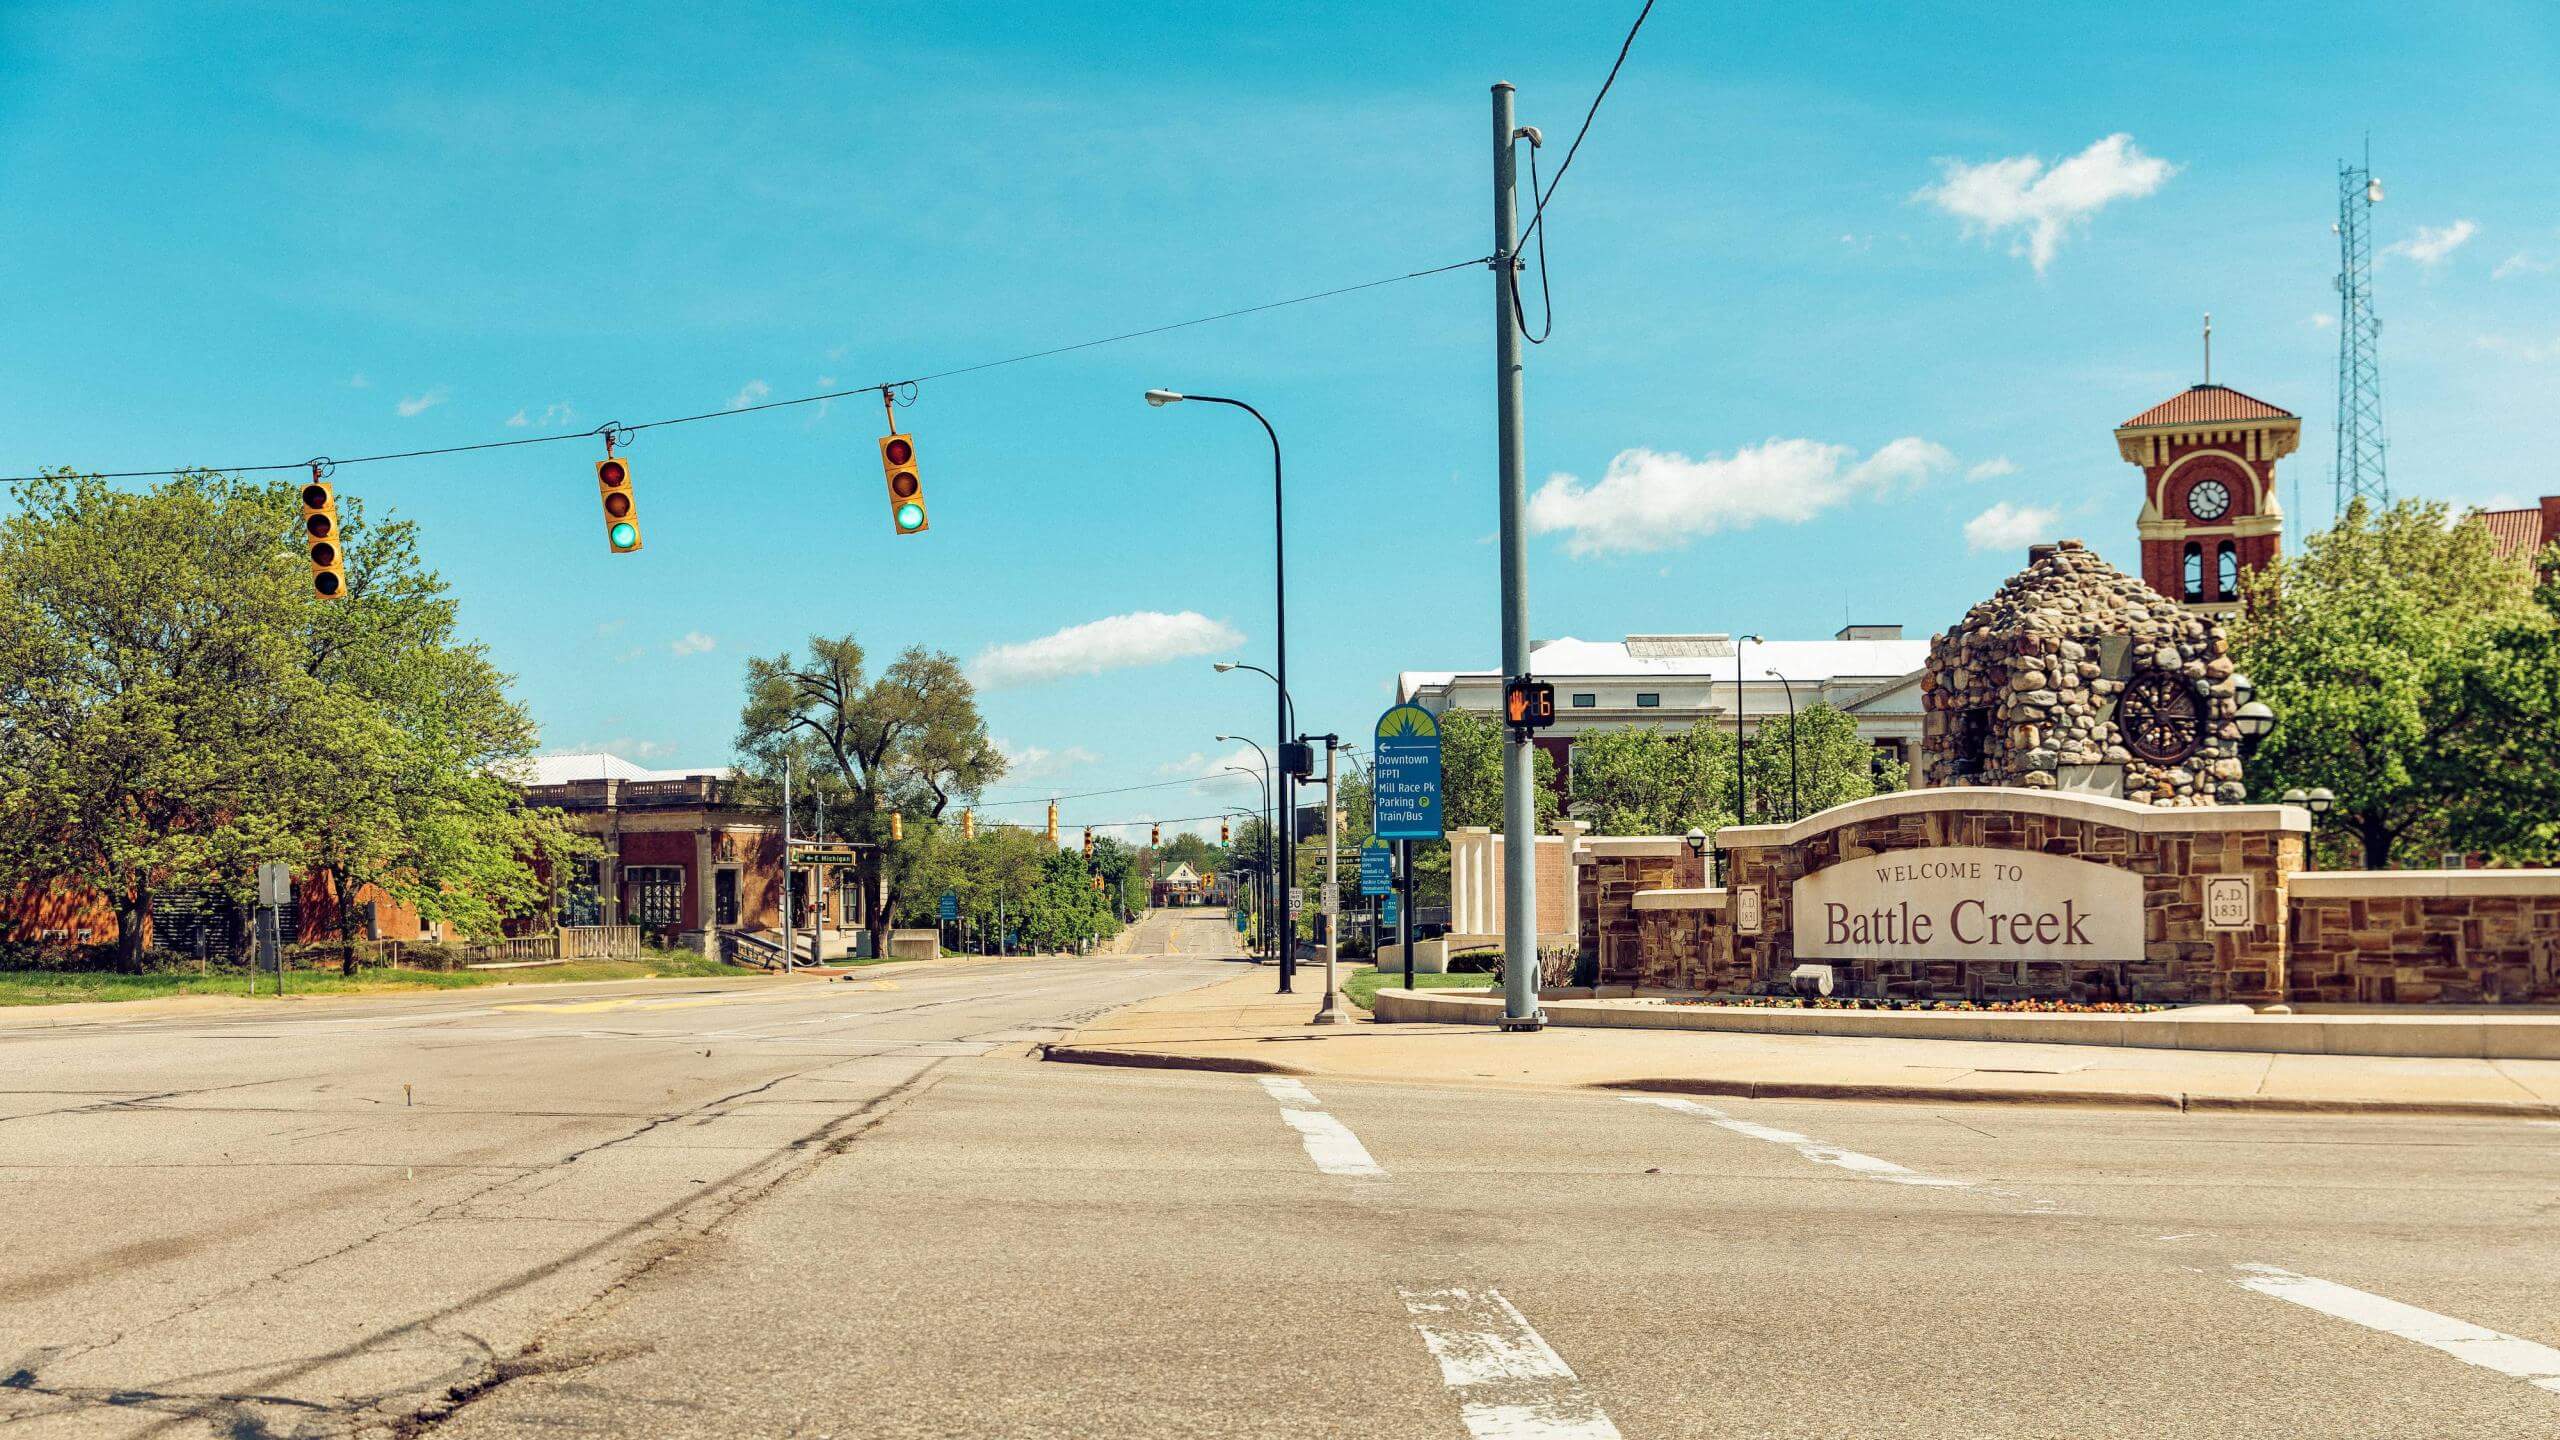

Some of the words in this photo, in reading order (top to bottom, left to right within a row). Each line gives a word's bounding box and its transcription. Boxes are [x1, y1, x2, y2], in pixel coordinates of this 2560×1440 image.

[1540, 690, 1550, 716] 6
[1378, 755, 1429, 765] Downtown
[1378, 769, 1400, 779] IFPTI
[1379, 782, 1395, 793] Mill
[1398, 783, 1421, 793] Race
[1423, 782, 1435, 793] Pk
[1379, 796, 1414, 809] Parking
[1379, 811, 1424, 822] Train/Bus
[821, 855, 851, 863] Michigan
[1876, 862, 1982, 883] WELCOME
[1994, 864, 2024, 882] TO
[2214, 888, 2244, 901] A.D.
[1741, 911, 1756, 922] 1831
[2214, 904, 2243, 917] 1831
[1823, 901, 1934, 945] Battle
[1950, 899, 2095, 946] Creek
